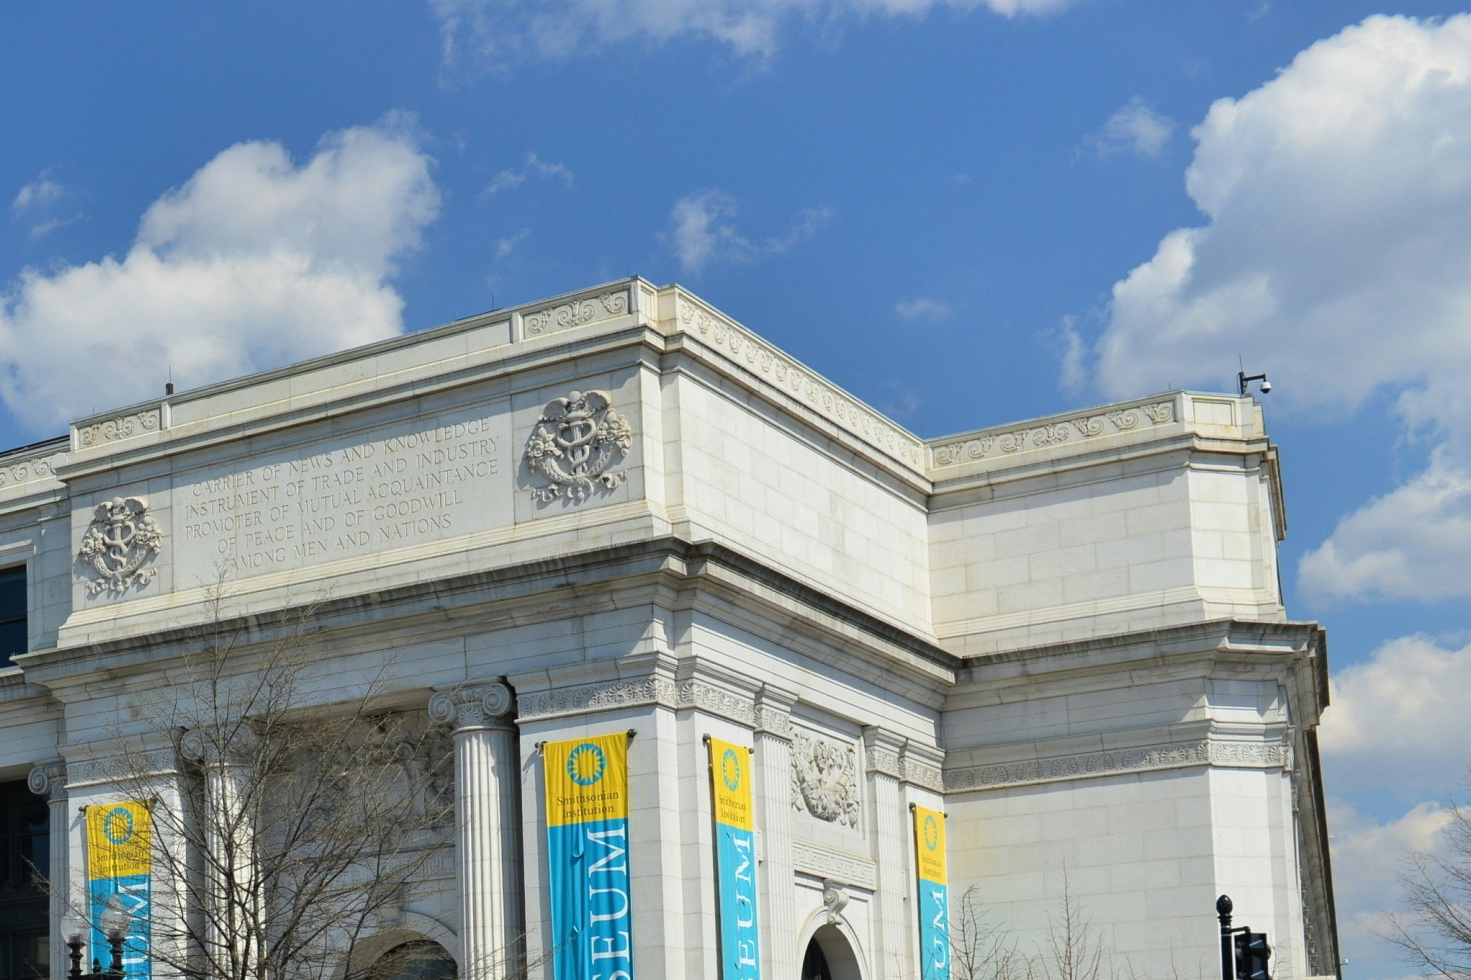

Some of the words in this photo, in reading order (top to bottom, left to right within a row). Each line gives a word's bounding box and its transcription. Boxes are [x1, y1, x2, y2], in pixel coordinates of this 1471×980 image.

[186, 486, 279, 519] INSTRUMENT
[285, 480, 305, 497] OF
[311, 467, 364, 491] TRADE
[373, 457, 408, 478] AND
[416, 436, 500, 469] INDUSTRY
[193, 472, 255, 497] CARRIER
[262, 465, 281, 482] OF
[289, 453, 333, 475] NEWS
[341, 443, 375, 464] AND
[384, 417, 490, 454] KNOWLEDGE
[186, 511, 263, 539] PROMOTER
[270, 505, 289, 522] OF
[297, 490, 362, 515] MUTUAL
[367, 459, 499, 500] ACQUAINTANCE
[217, 536, 237, 554] OF
[245, 525, 295, 548] PEACE
[303, 516, 336, 536] AND
[344, 509, 365, 527] OF
[373, 490, 463, 521] GOODWILL
[230, 547, 286, 572] AMONG
[295, 540, 327, 558] MEN
[336, 531, 370, 550] AND
[380, 513, 452, 542] NATIONS
[557, 790, 619, 807] Smithsonian
[561, 803, 615, 820] Institution
